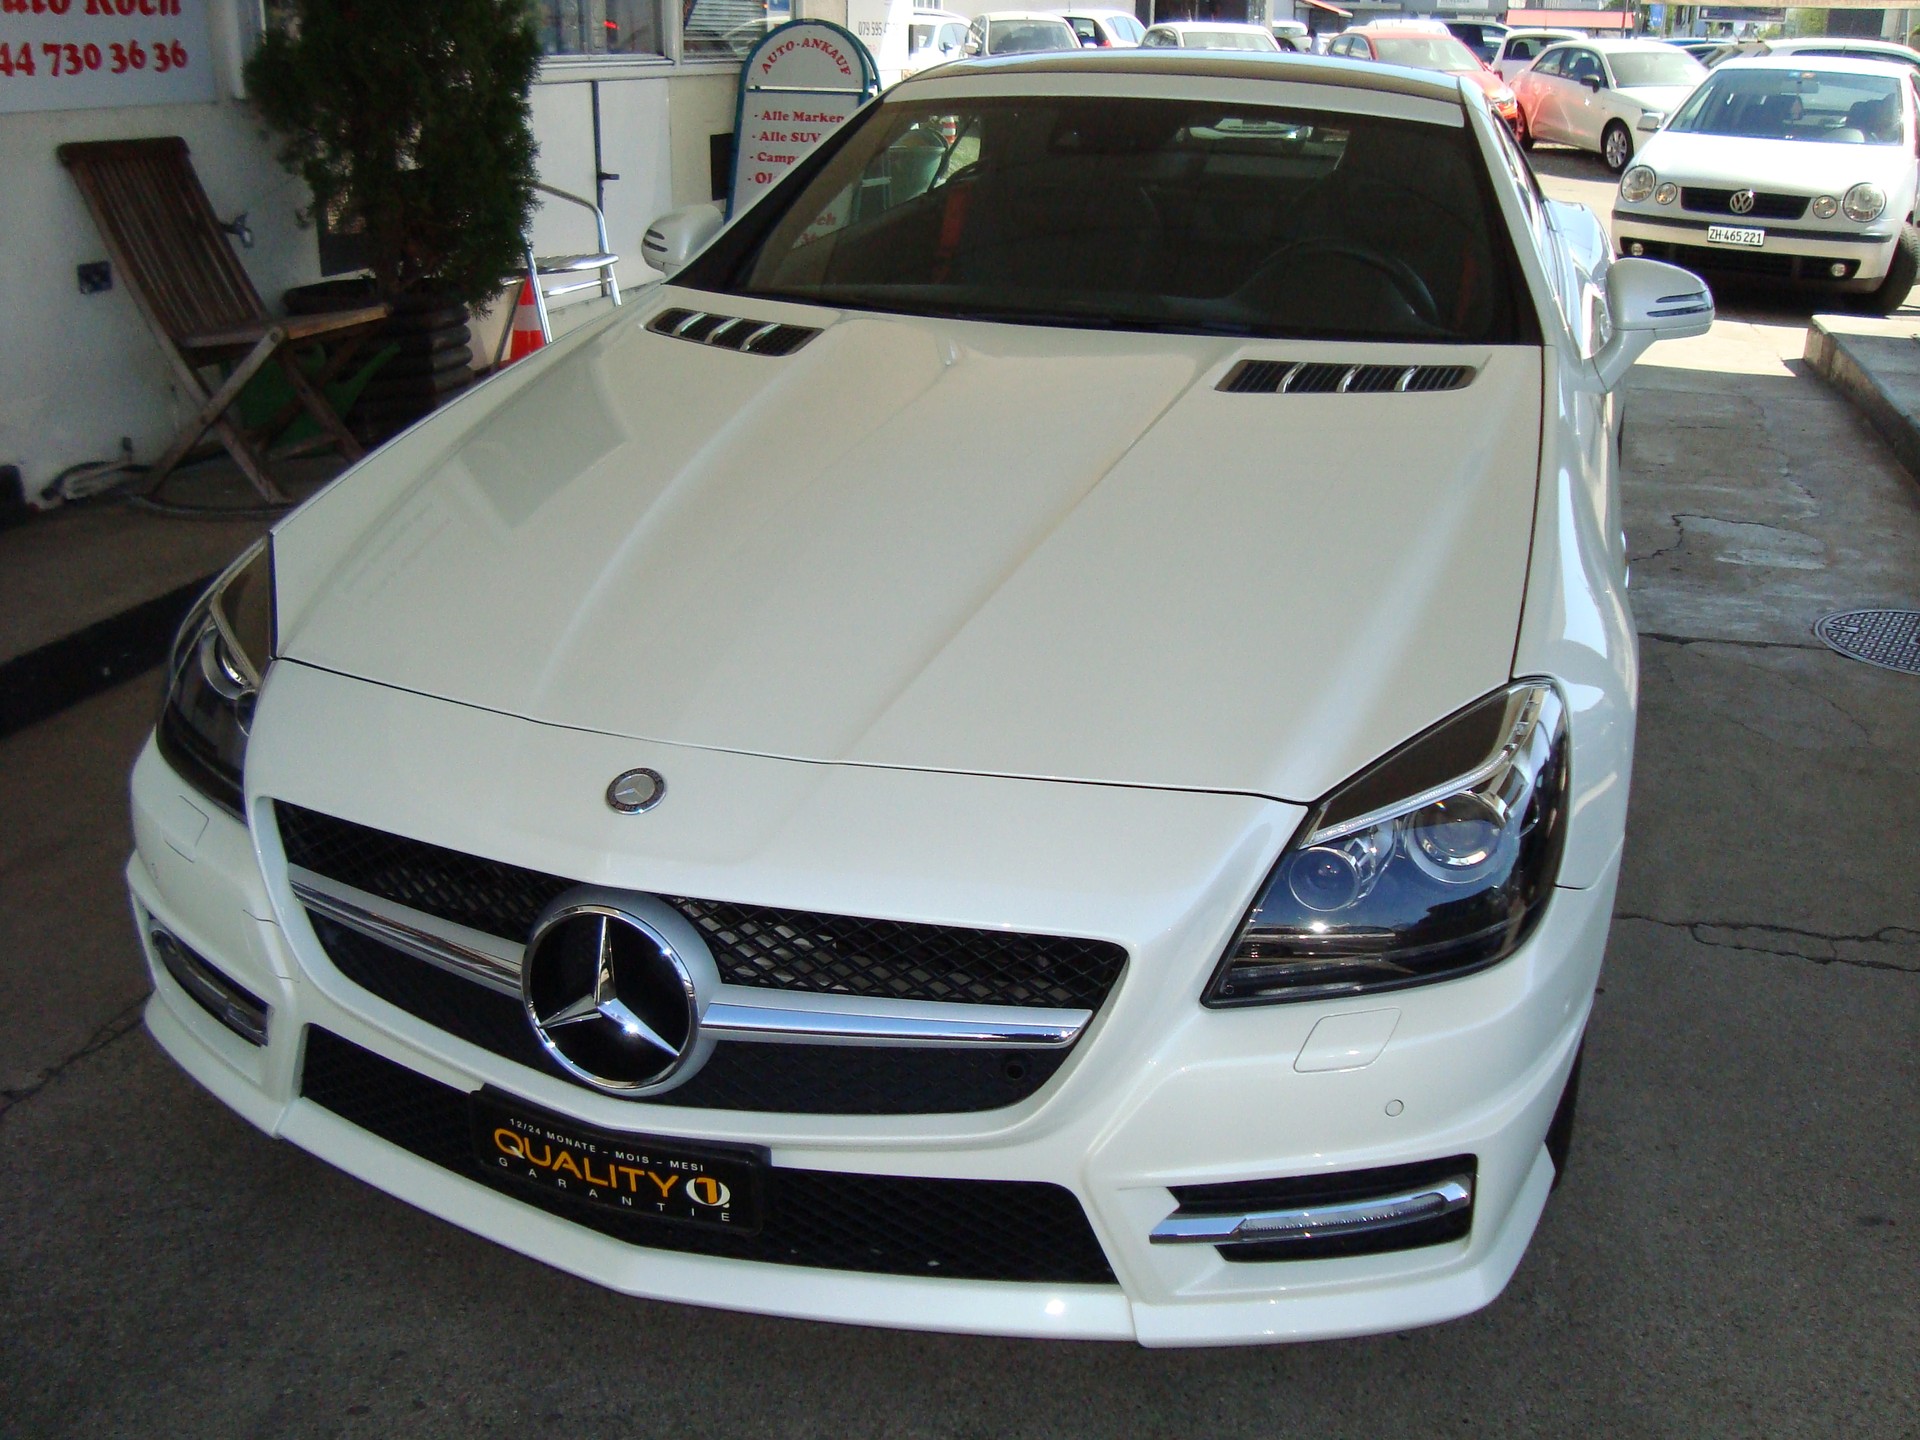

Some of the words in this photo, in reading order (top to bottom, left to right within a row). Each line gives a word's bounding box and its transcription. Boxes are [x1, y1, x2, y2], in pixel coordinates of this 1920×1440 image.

[43, 43, 102, 77] 730
[109, 39, 147, 74] 36
[152, 38, 188, 73] 36
[761, 110, 790, 121] Alle
[759, 131, 788, 142] Alle
[757, 151, 799, 165] Camp
[493, 1127, 679, 1198] QUALITY
[509, 1118, 541, 1136] 12/24
[546, 1131, 596, 1153] MONATE
[615, 1150, 649, 1164] MOIS
[670, 1160, 704, 1172] MESI
[498, 1156, 731, 1223] GARANTIE
